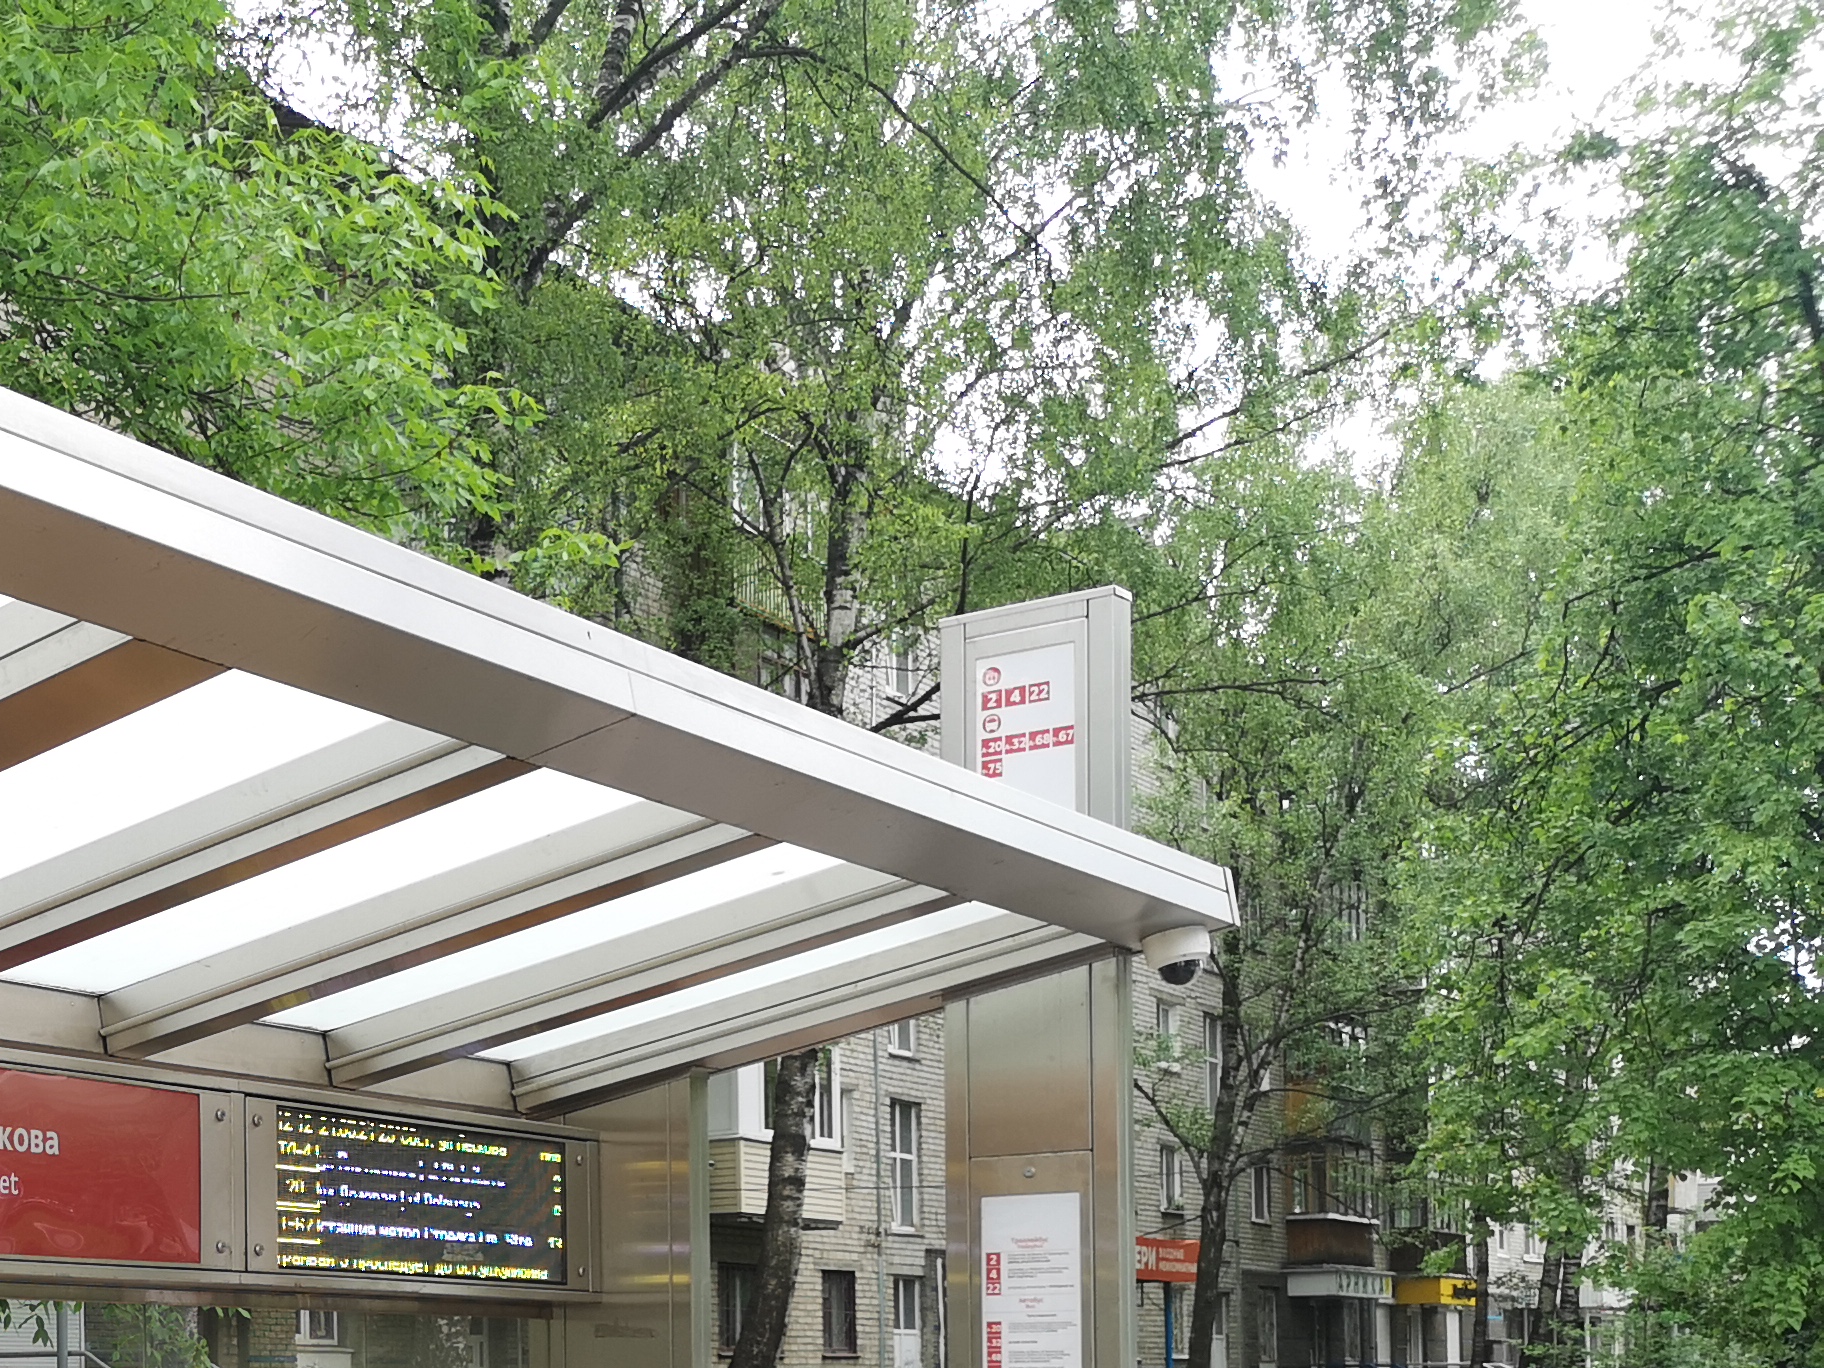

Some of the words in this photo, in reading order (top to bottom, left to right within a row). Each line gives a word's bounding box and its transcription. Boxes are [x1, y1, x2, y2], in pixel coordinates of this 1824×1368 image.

[986, 693, 997, 708] 2
[1009, 689, 1021, 703] 4
[1029, 684, 1049, 701] 22
[988, 1254, 998, 1266] 2
[988, 1268, 998, 1280] 4
[986, 1283, 1001, 1294] 22
